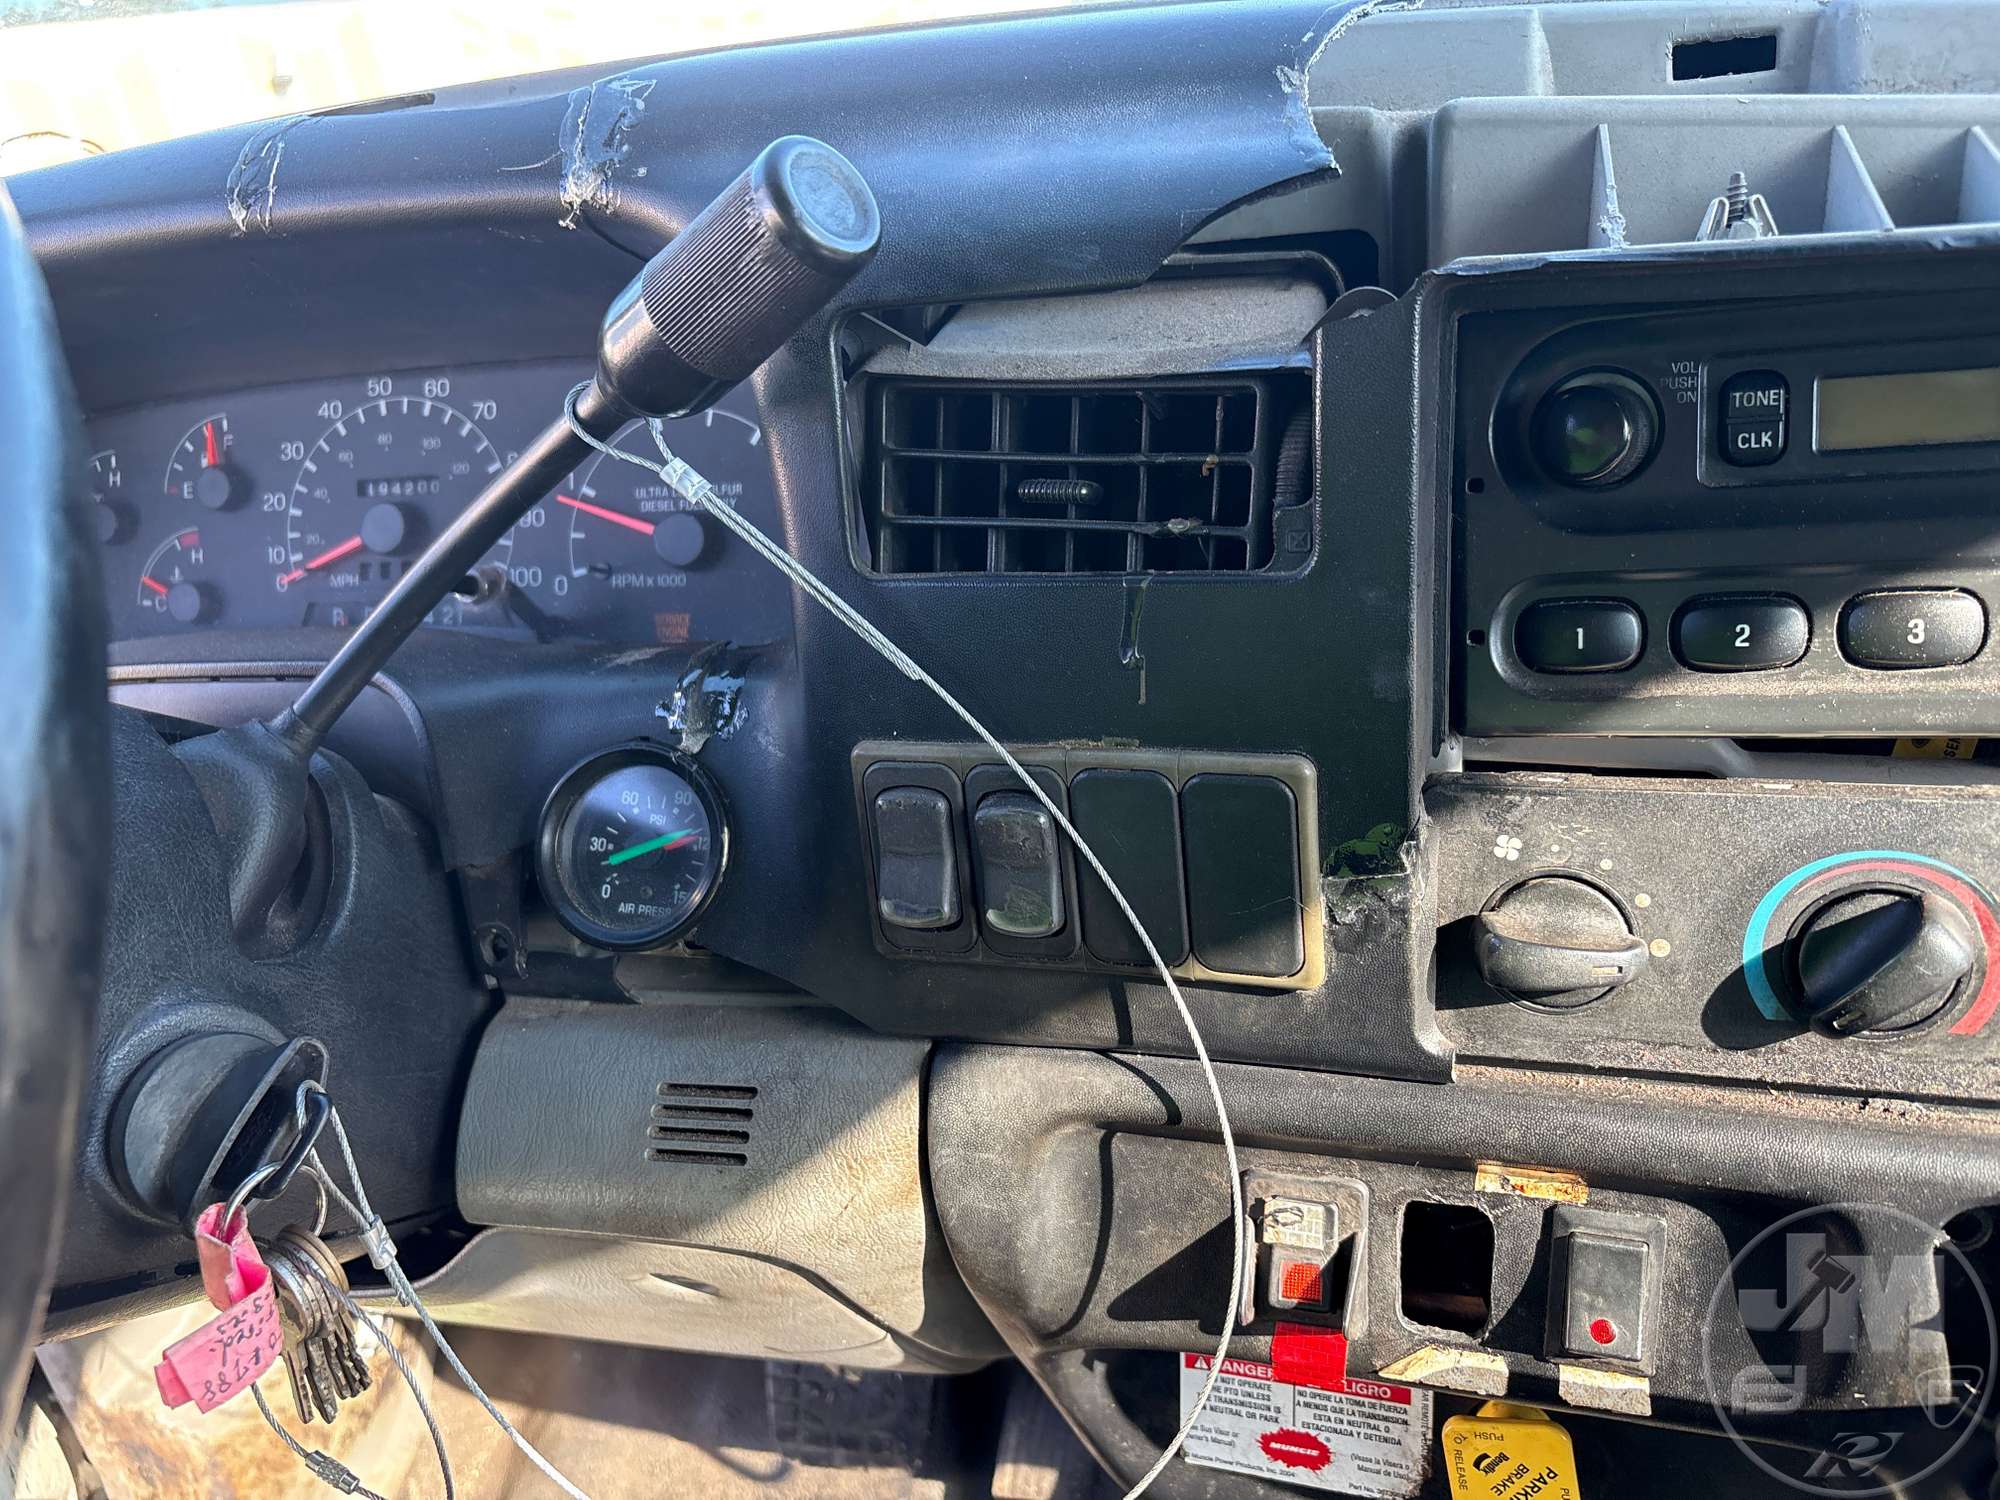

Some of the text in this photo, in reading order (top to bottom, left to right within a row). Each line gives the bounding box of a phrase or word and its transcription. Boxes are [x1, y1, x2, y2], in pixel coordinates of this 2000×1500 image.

[1671, 361, 1698, 374] VOL
[367, 377, 392, 397] 50
[424, 378, 450, 398] 60
[1660, 377, 1698, 390] PUSH
[1676, 391, 1698, 403] ON
[1732, 389, 1781, 408] TONE
[318, 400, 343, 419] 40
[472, 400, 497, 420] 70
[1737, 431, 1773, 450] CLK
[280, 442, 304, 460] 30
[452, 461, 470, 474] 120
[109, 471, 121, 488] H
[183, 483, 194, 500] E
[635, 487, 669, 499] ULTRA
[263, 493, 286, 512] 20
[640, 499, 676, 512] DIESEL
[191, 549, 204, 563] H
[267, 546, 285, 564] 10
[276, 577, 289, 592] 0
[329, 574, 360, 587] MPH
[554, 576, 568, 595] 0
[611, 574, 644, 589] RPM
[657, 573, 687, 587] 1000
[155, 596, 167, 612] C
[1575, 627, 1585, 650] 1
[1734, 623, 1750, 648] 2
[1906, 617, 1926, 645] 3
[621, 791, 639, 806] 60
[674, 791, 692, 806] 90
[649, 814, 667, 826] PSI
[589, 836, 607, 852] 30
[696, 836, 709, 851] 12
[601, 884, 611, 899] 0
[673, 890, 688, 905] 15
[618, 902, 636, 914] AIR
[1209, 1357, 1274, 1379] ANGE
[1219, 1375, 1233, 1385] NOT
[1236, 1378, 1272, 1392] OPERATE
[1344, 1380, 1391, 1399] LIGRO
[1223, 1387, 1240, 1397] PTO
[1240, 1389, 1271, 1402] UNLESS
[1296, 1389, 1408, 1416] NO OPERE LA TOMA DE FUERZA
[1213, 1394, 1271, 1412] TRANSMISSION
[1273, 1405, 1281, 1414] IS
[1302, 1400, 1329, 1412] MENOS
[1329, 1406, 1345, 1415] QUE
[1346, 1408, 1357, 1418] LA
[1209, 1404, 1244, 1418] NEUTRAL
[1245, 1412, 1257, 1420] OR
[1259, 1414, 1280, 1424] PARK
[1313, 1412, 1332, 1424] ESTA
[1333, 1416, 1344, 1425] EN
[1346, 1417, 1382, 1432] NEUTRAL
[1301, 1420, 1402, 1447] ESTACIONADA Y DETENIDA
[1473, 1431, 1505, 1442] PUSH
[1268, 1441, 1321, 1457] MUNCIE
[1453, 1432, 1469, 1491] TO RELEASE
[1489, 1462, 1531, 1497] BRAKE
[1509, 1465, 1559, 1500] PARKI
